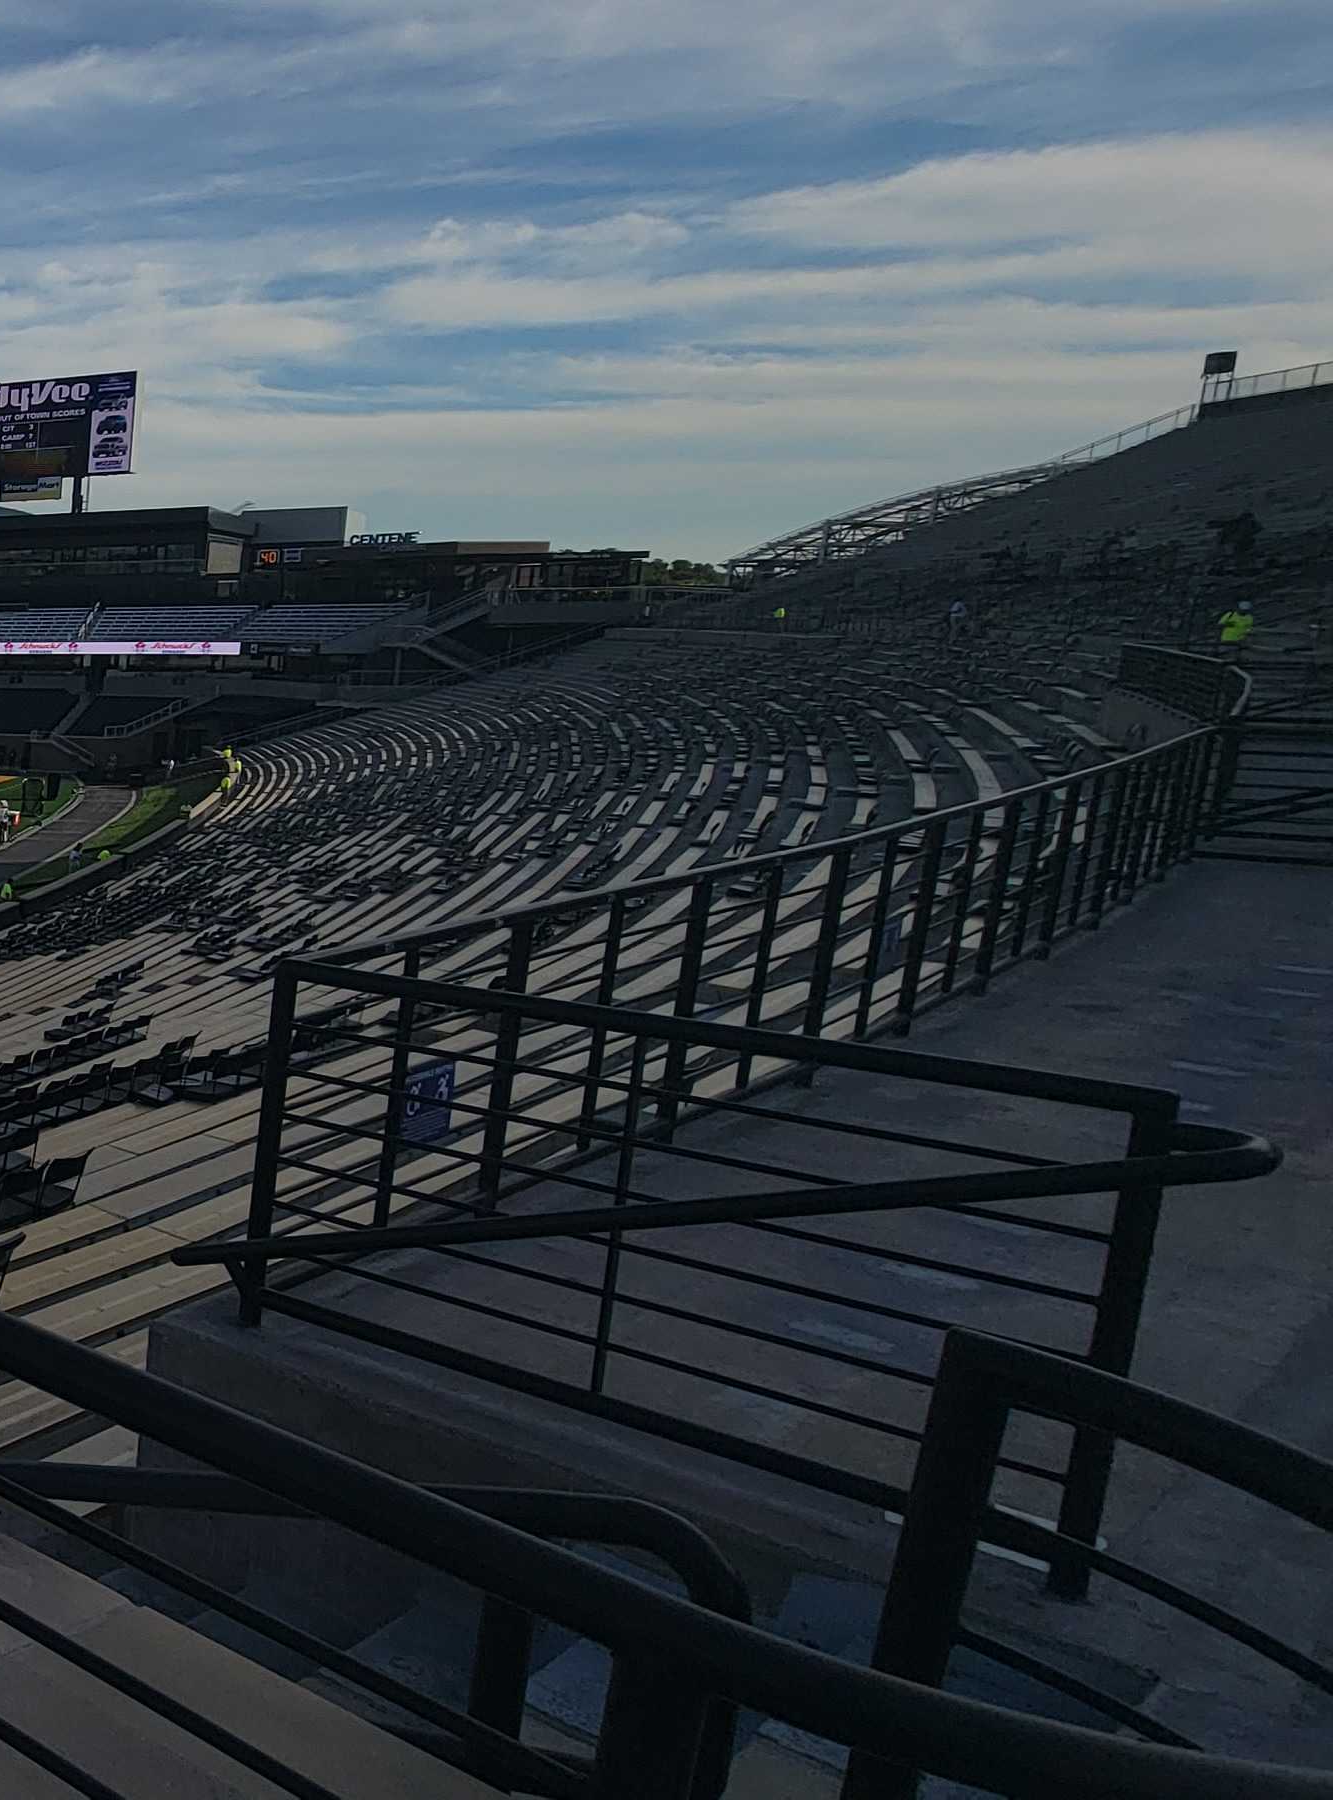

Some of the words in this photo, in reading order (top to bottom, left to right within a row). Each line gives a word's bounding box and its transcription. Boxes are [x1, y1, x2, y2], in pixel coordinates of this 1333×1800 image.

[14, 413, 25, 421] OF
[26, 411, 50, 420] TOWN
[52, 408, 86, 418] SCORES
[350, 532, 420, 545] CENTENE
[261, 552, 277, 563] 40
